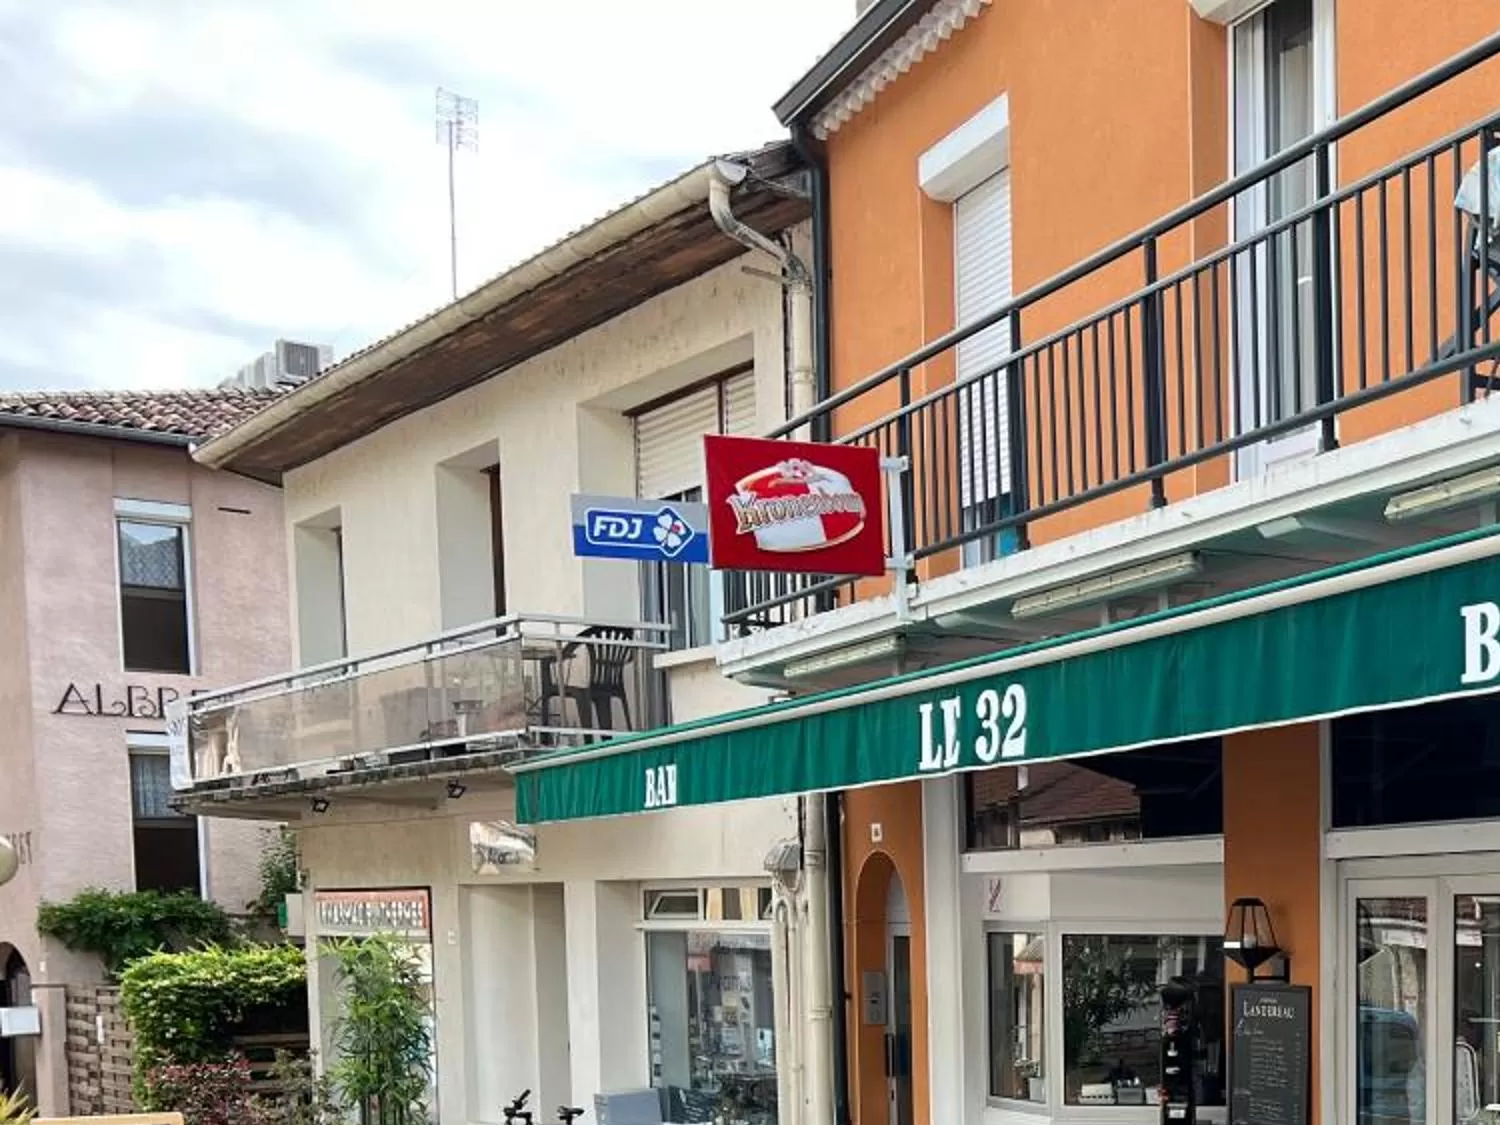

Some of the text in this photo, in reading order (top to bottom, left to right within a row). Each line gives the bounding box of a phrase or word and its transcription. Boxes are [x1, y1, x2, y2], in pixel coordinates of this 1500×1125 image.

[593, 516, 642, 540] FDJ
[918, 683, 1027, 771] LE 32
